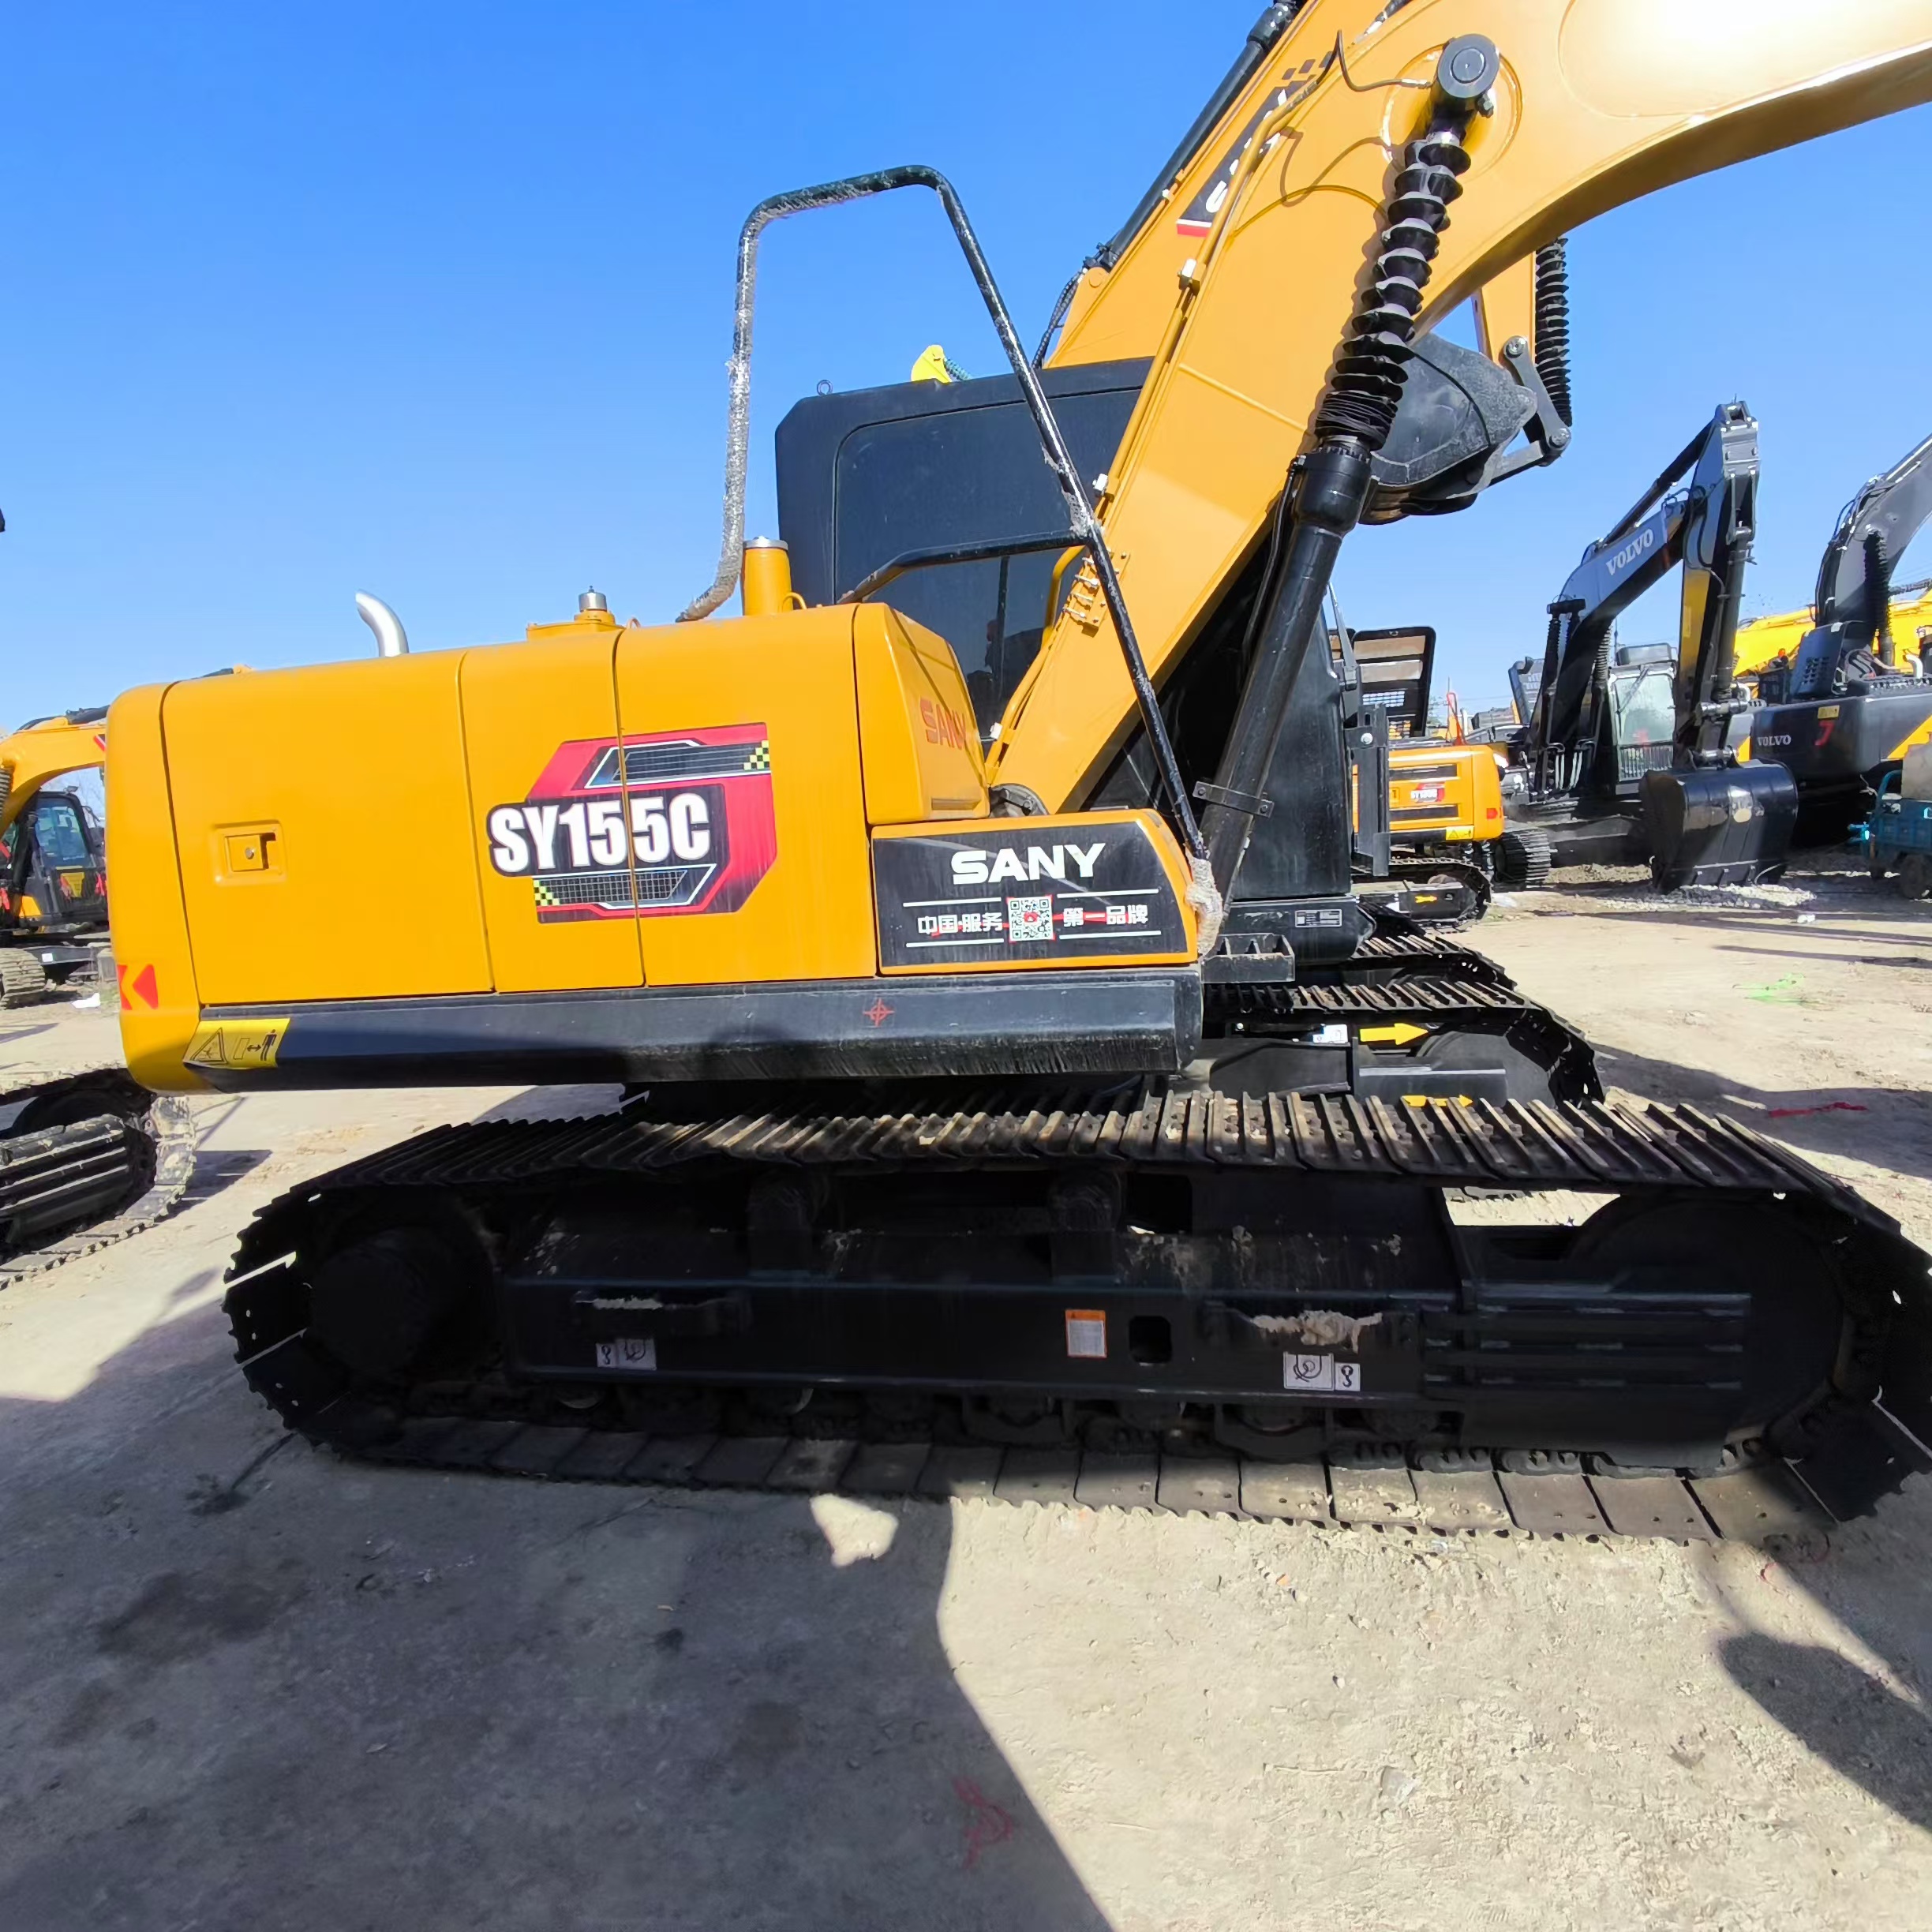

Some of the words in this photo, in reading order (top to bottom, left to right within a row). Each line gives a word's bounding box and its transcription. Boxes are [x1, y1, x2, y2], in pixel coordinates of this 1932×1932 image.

[1605, 529, 1653, 575] VOLVO
[1756, 734, 1792, 747] VOLVO
[489, 792, 711, 873] SY155C
[951, 843, 1106, 885] SANY
[1062, 904, 1149, 928] 第一品牌
